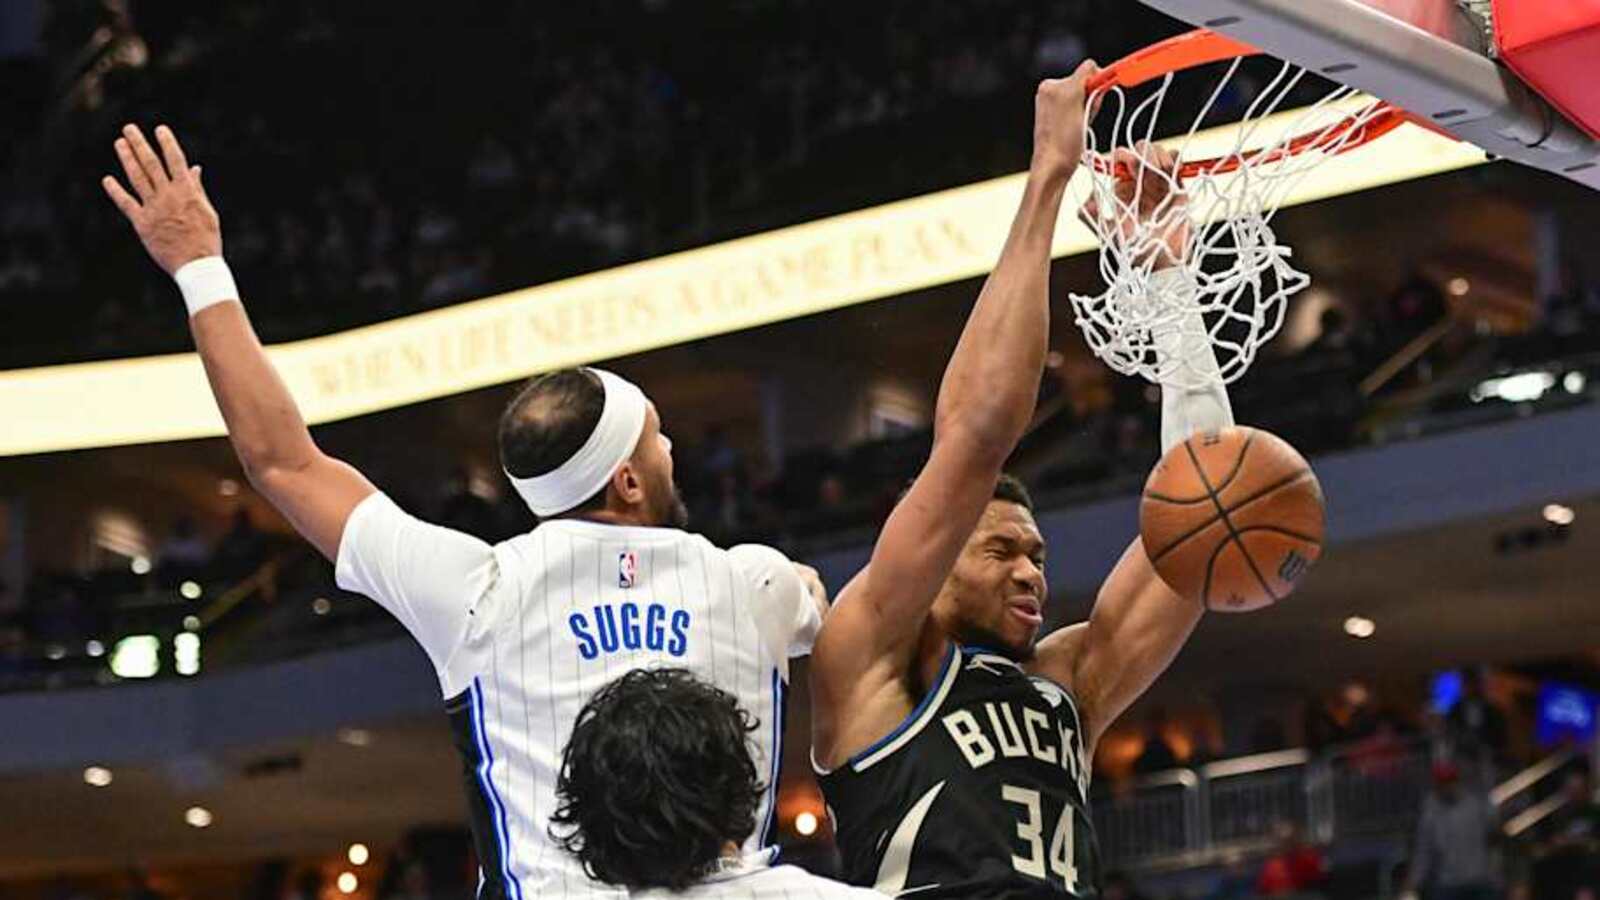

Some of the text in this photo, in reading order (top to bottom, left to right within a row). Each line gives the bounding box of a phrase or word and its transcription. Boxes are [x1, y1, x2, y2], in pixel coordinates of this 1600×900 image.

[310, 217, 976, 397] WHEN LIFE NEEDS A GAME PLAN
[568, 603, 690, 660] SUGGS
[1002, 784, 1080, 896] 34
